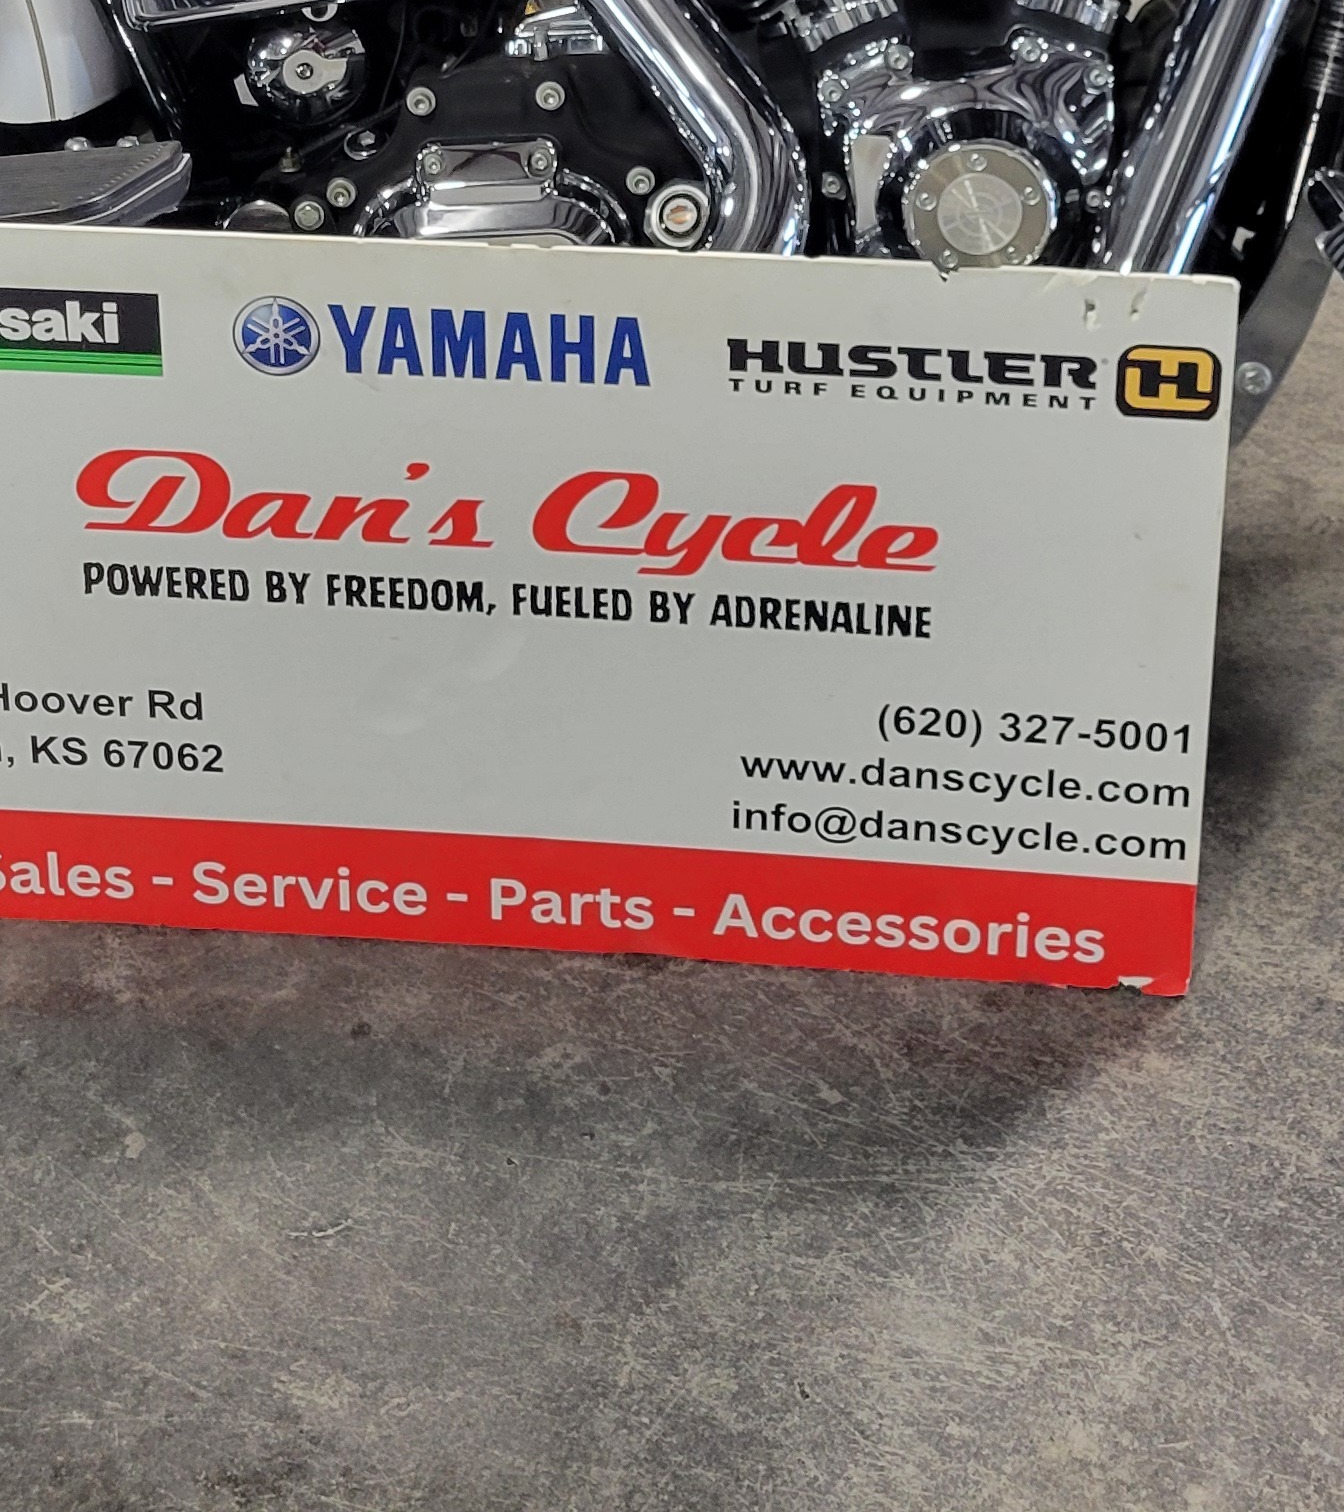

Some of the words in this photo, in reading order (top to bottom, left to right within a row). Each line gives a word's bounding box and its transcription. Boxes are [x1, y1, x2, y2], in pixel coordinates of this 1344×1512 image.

[328, 303, 650, 386] YAMAHA
[727, 338, 1098, 390] HUSTLER
[729, 377, 828, 396] TURF
[850, 384, 1096, 411] EQUIPMENT
[76, 449, 494, 548] Dan's
[532, 471, 939, 576] Cycle
[83, 561, 250, 602] POWERED
[266, 570, 312, 605] BY
[326, 574, 496, 617] FREEDOM,
[512, 583, 633, 622] FUELED
[649, 590, 696, 625] BY
[709, 594, 932, 639] ADRENALINE
[148, 689, 203, 721] Rd
[878, 703, 983, 748] (620)
[998, 711, 1191, 754] 327-5001
[30, 735, 88, 766] KS
[103, 739, 224, 773] 67062
[740, 754, 1191, 808] www.danscycle.com
[731, 800, 1188, 862] info@danscycle.com
[191, 861, 429, 916] Service
[489, 876, 655, 931] Parts
[712, 892, 1106, 967] Accessories
